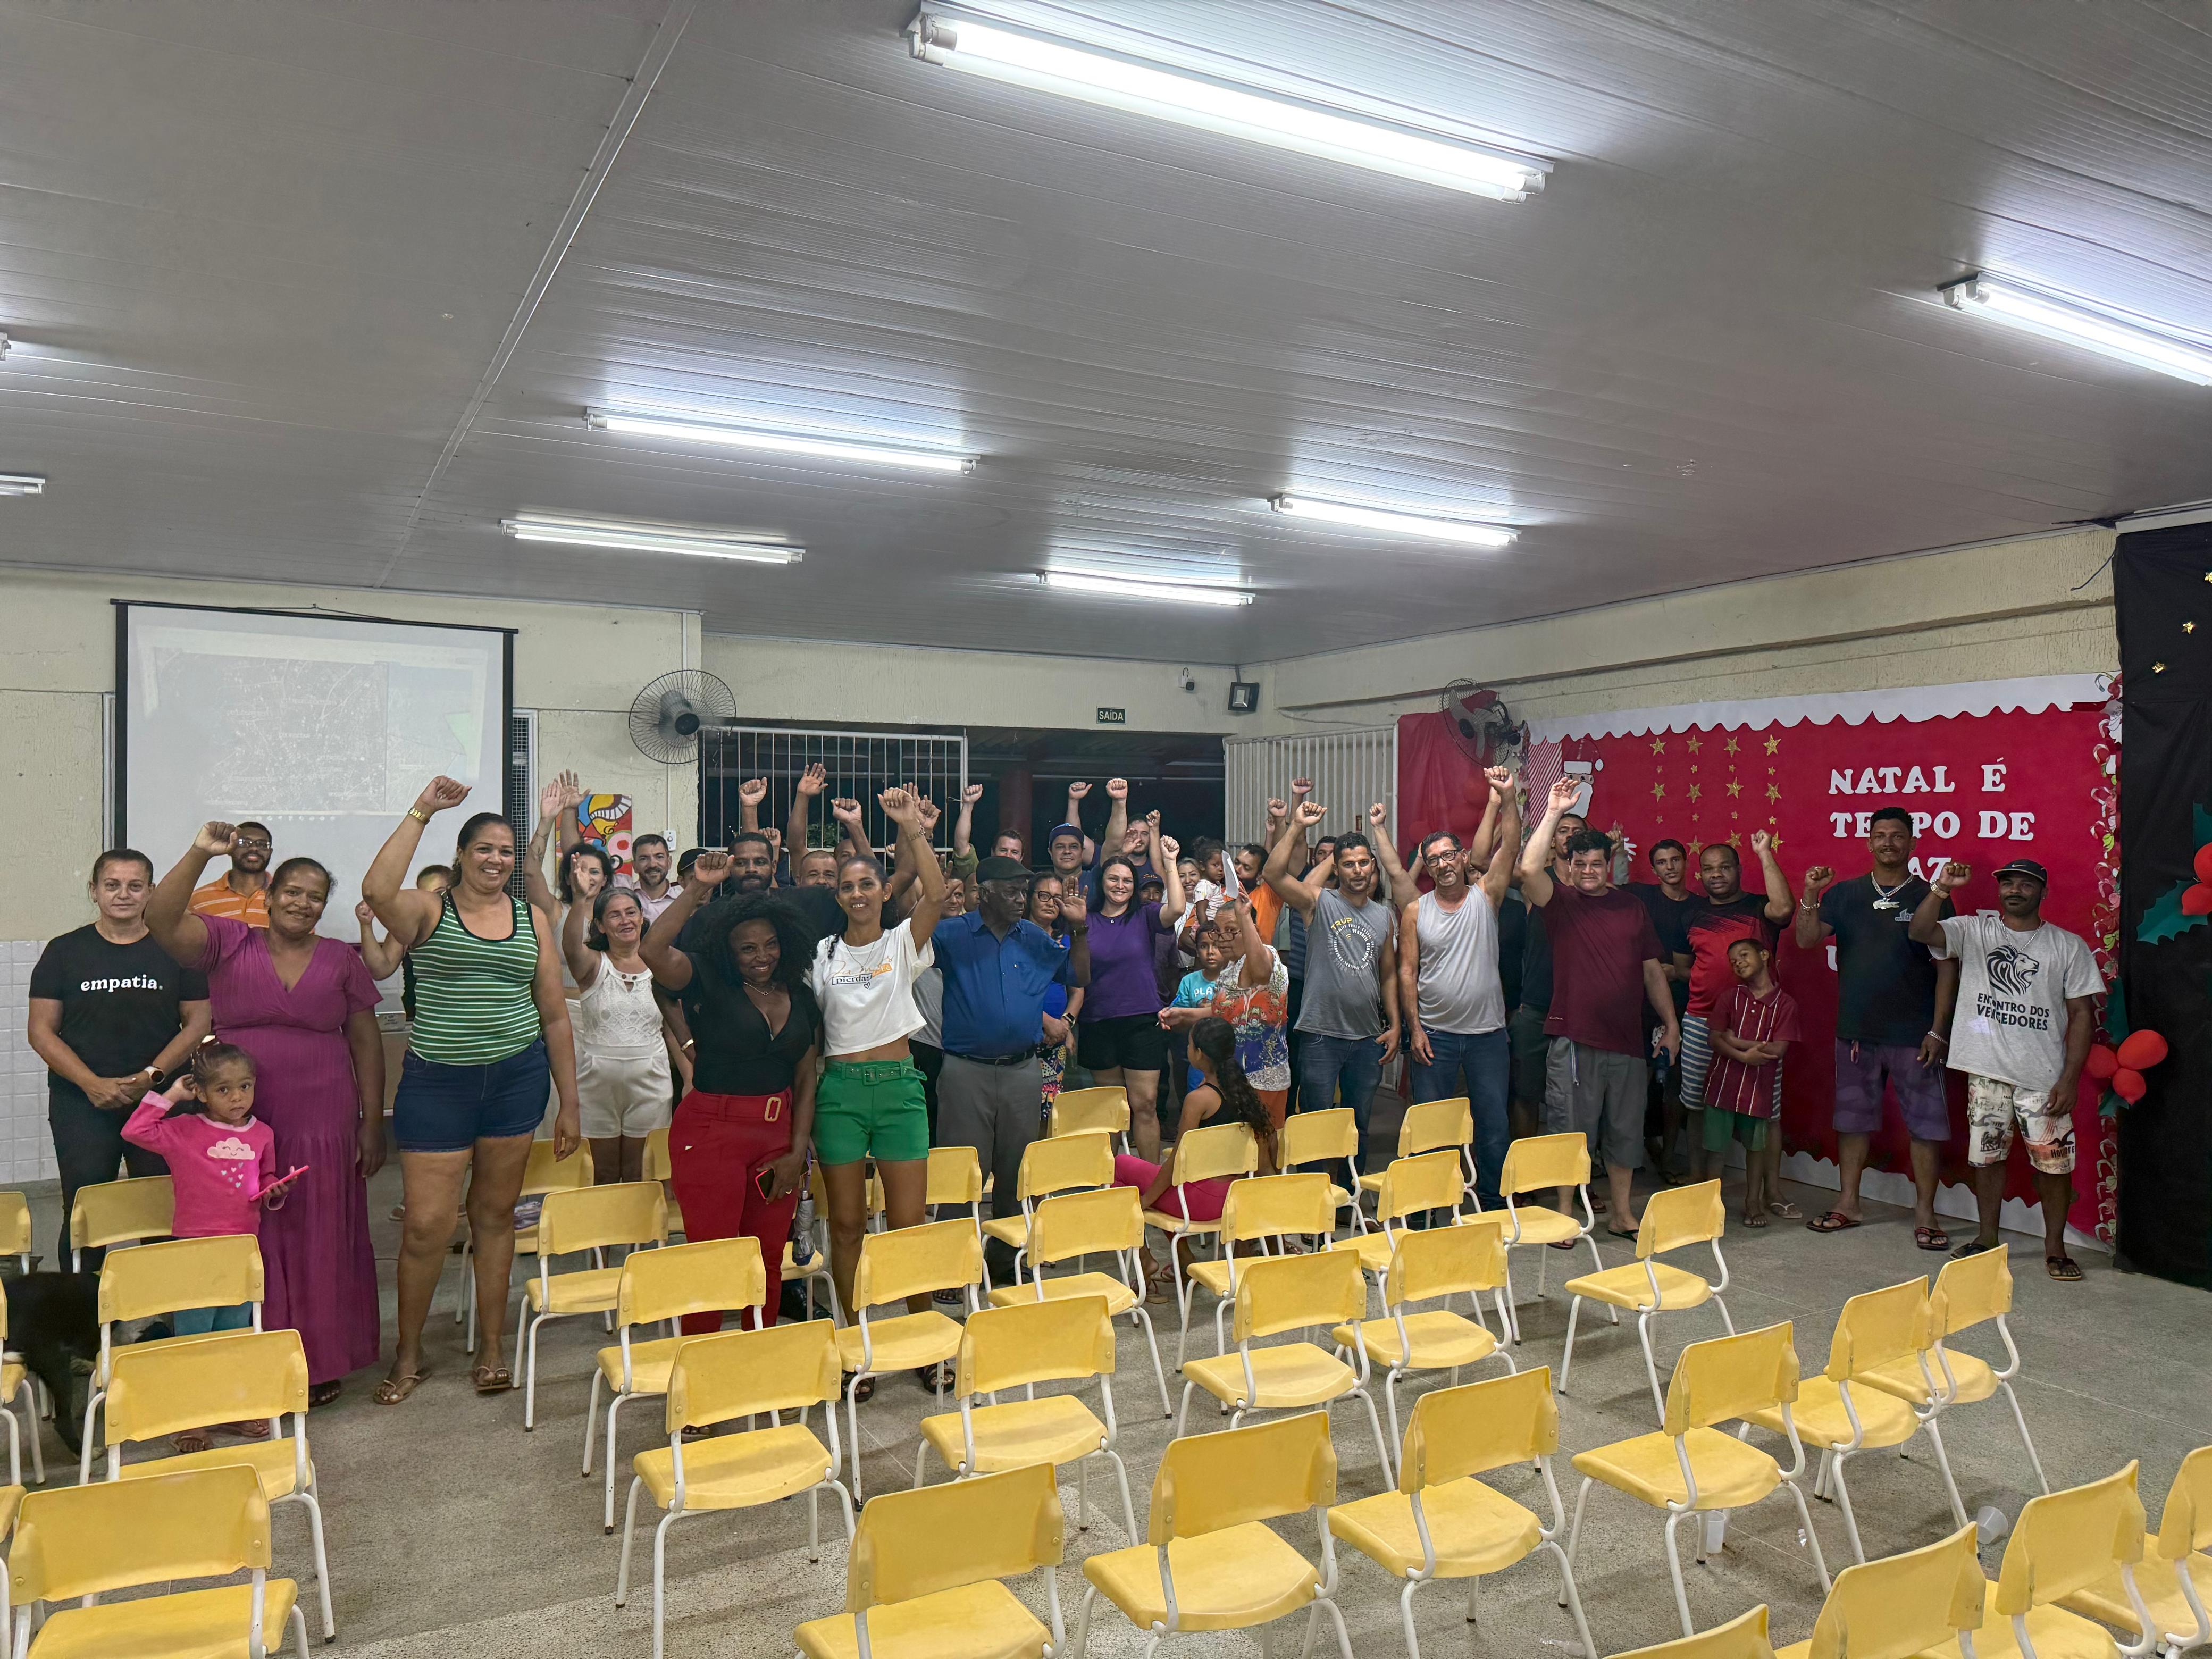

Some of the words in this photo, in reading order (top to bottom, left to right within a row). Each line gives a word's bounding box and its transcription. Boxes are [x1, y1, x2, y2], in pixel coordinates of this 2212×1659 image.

[1099, 709, 1123, 720] SAÍDA
[1828, 766, 1955, 794] NATAL
[1981, 757, 2007, 792] É
[1830, 811, 1960, 839] TEPO
[1978, 811, 2035, 840] DE
[1908, 857, 1951, 883] AZ
[81, 974, 163, 992] empatia.
[1194, 987, 1212, 997] PLA
[2030, 1006, 2049, 1018] DOS
